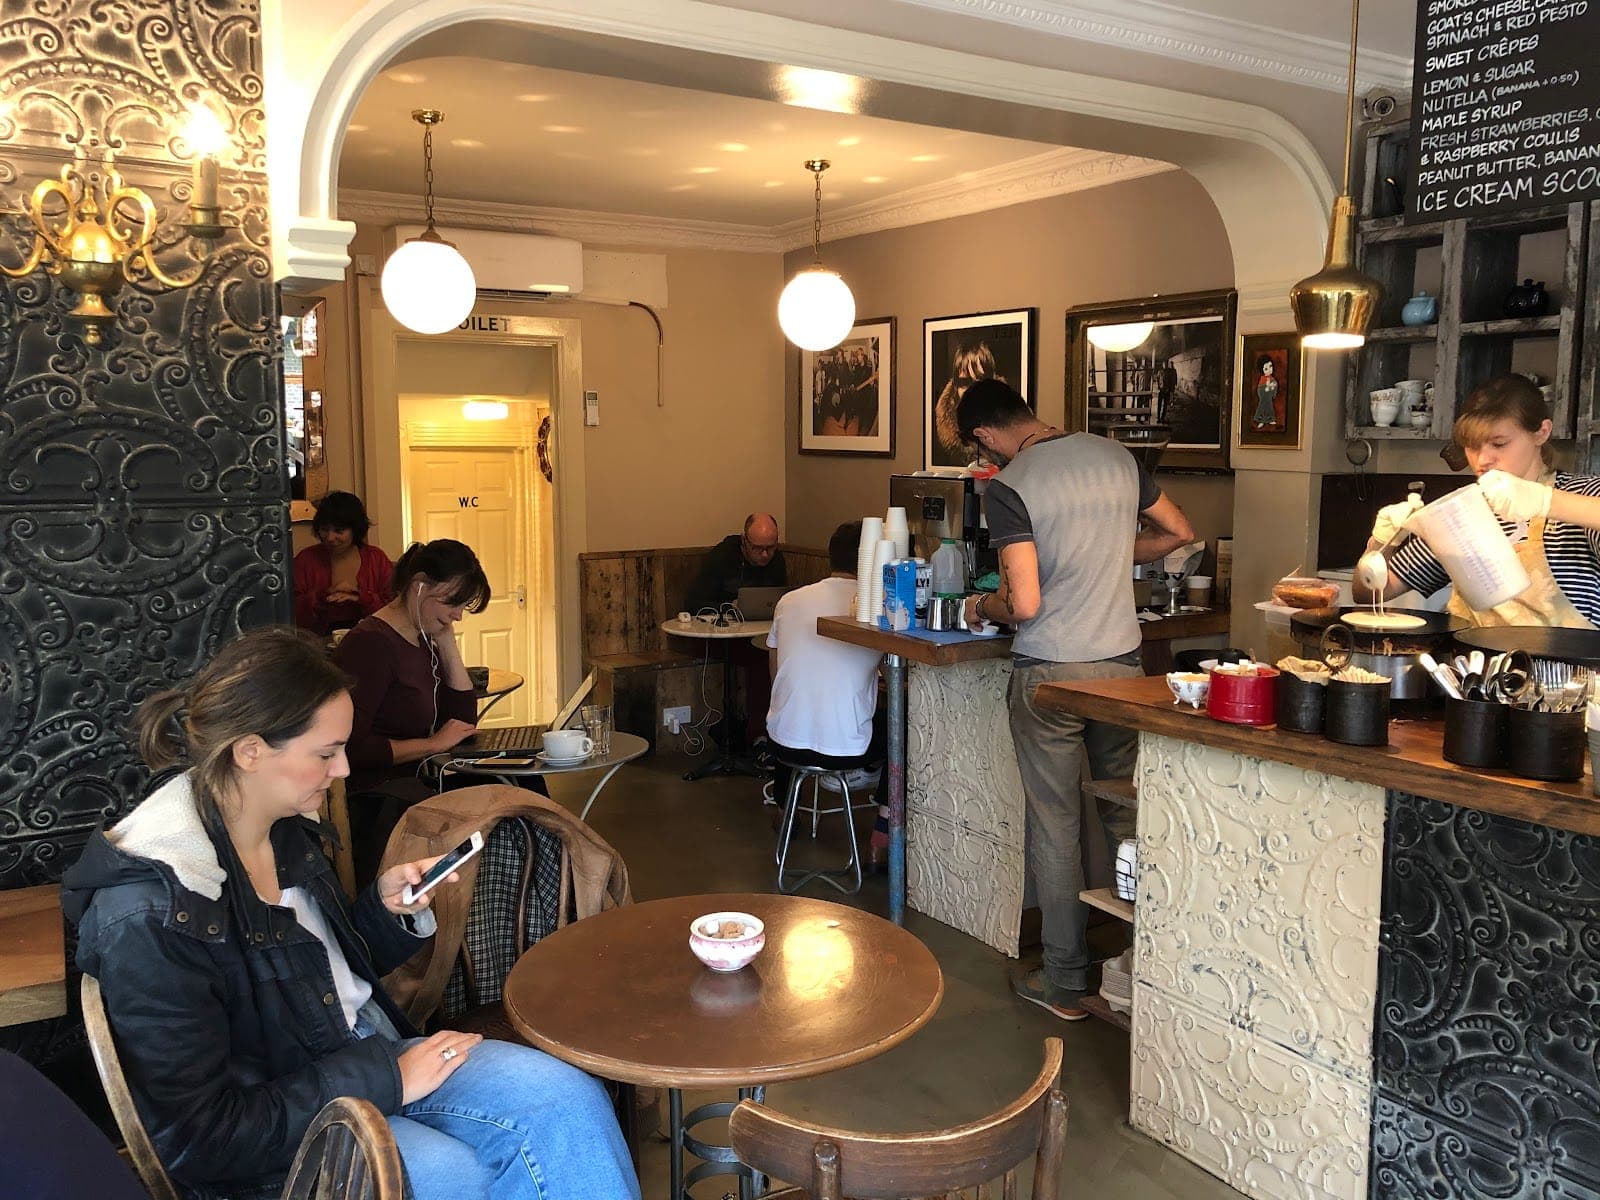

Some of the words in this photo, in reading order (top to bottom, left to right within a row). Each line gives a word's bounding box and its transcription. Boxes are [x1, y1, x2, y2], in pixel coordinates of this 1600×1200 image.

[1427, 11, 1473, 35] GOAT'S
[1428, 0, 1478, 16] SMOK
[1427, 22, 1490, 51] SPINACH
[1494, 21, 1503, 31] &
[1507, 12, 1536, 31] RED
[1540, 1, 1588, 24] PESTO
[1425, 48, 1474, 73] SWEET
[1477, 34, 1539, 61] CRÊPES
[1423, 73, 1470, 96] LEMON
[1472, 72, 1481, 83] &
[1484, 60, 1535, 83] SUGAR
[1422, 89, 1488, 115] NUTELLA
[1491, 80, 1540, 101] (BANANA
[1421, 111, 1468, 132] MAPLE
[1471, 100, 1522, 123] SYRUP
[1420, 130, 1467, 151] FRESH
[1420, 153, 1430, 166] &
[1434, 137, 1520, 164] RASPBERRY
[1523, 127, 1580, 149] COULIS
[1418, 165, 1474, 186] PEANUT
[1476, 154, 1541, 176] BUTTER,
[1417, 190, 1448, 213] ICE
[1454, 176, 1533, 208] CREAM
[1541, 166, 1600, 196] SCO
